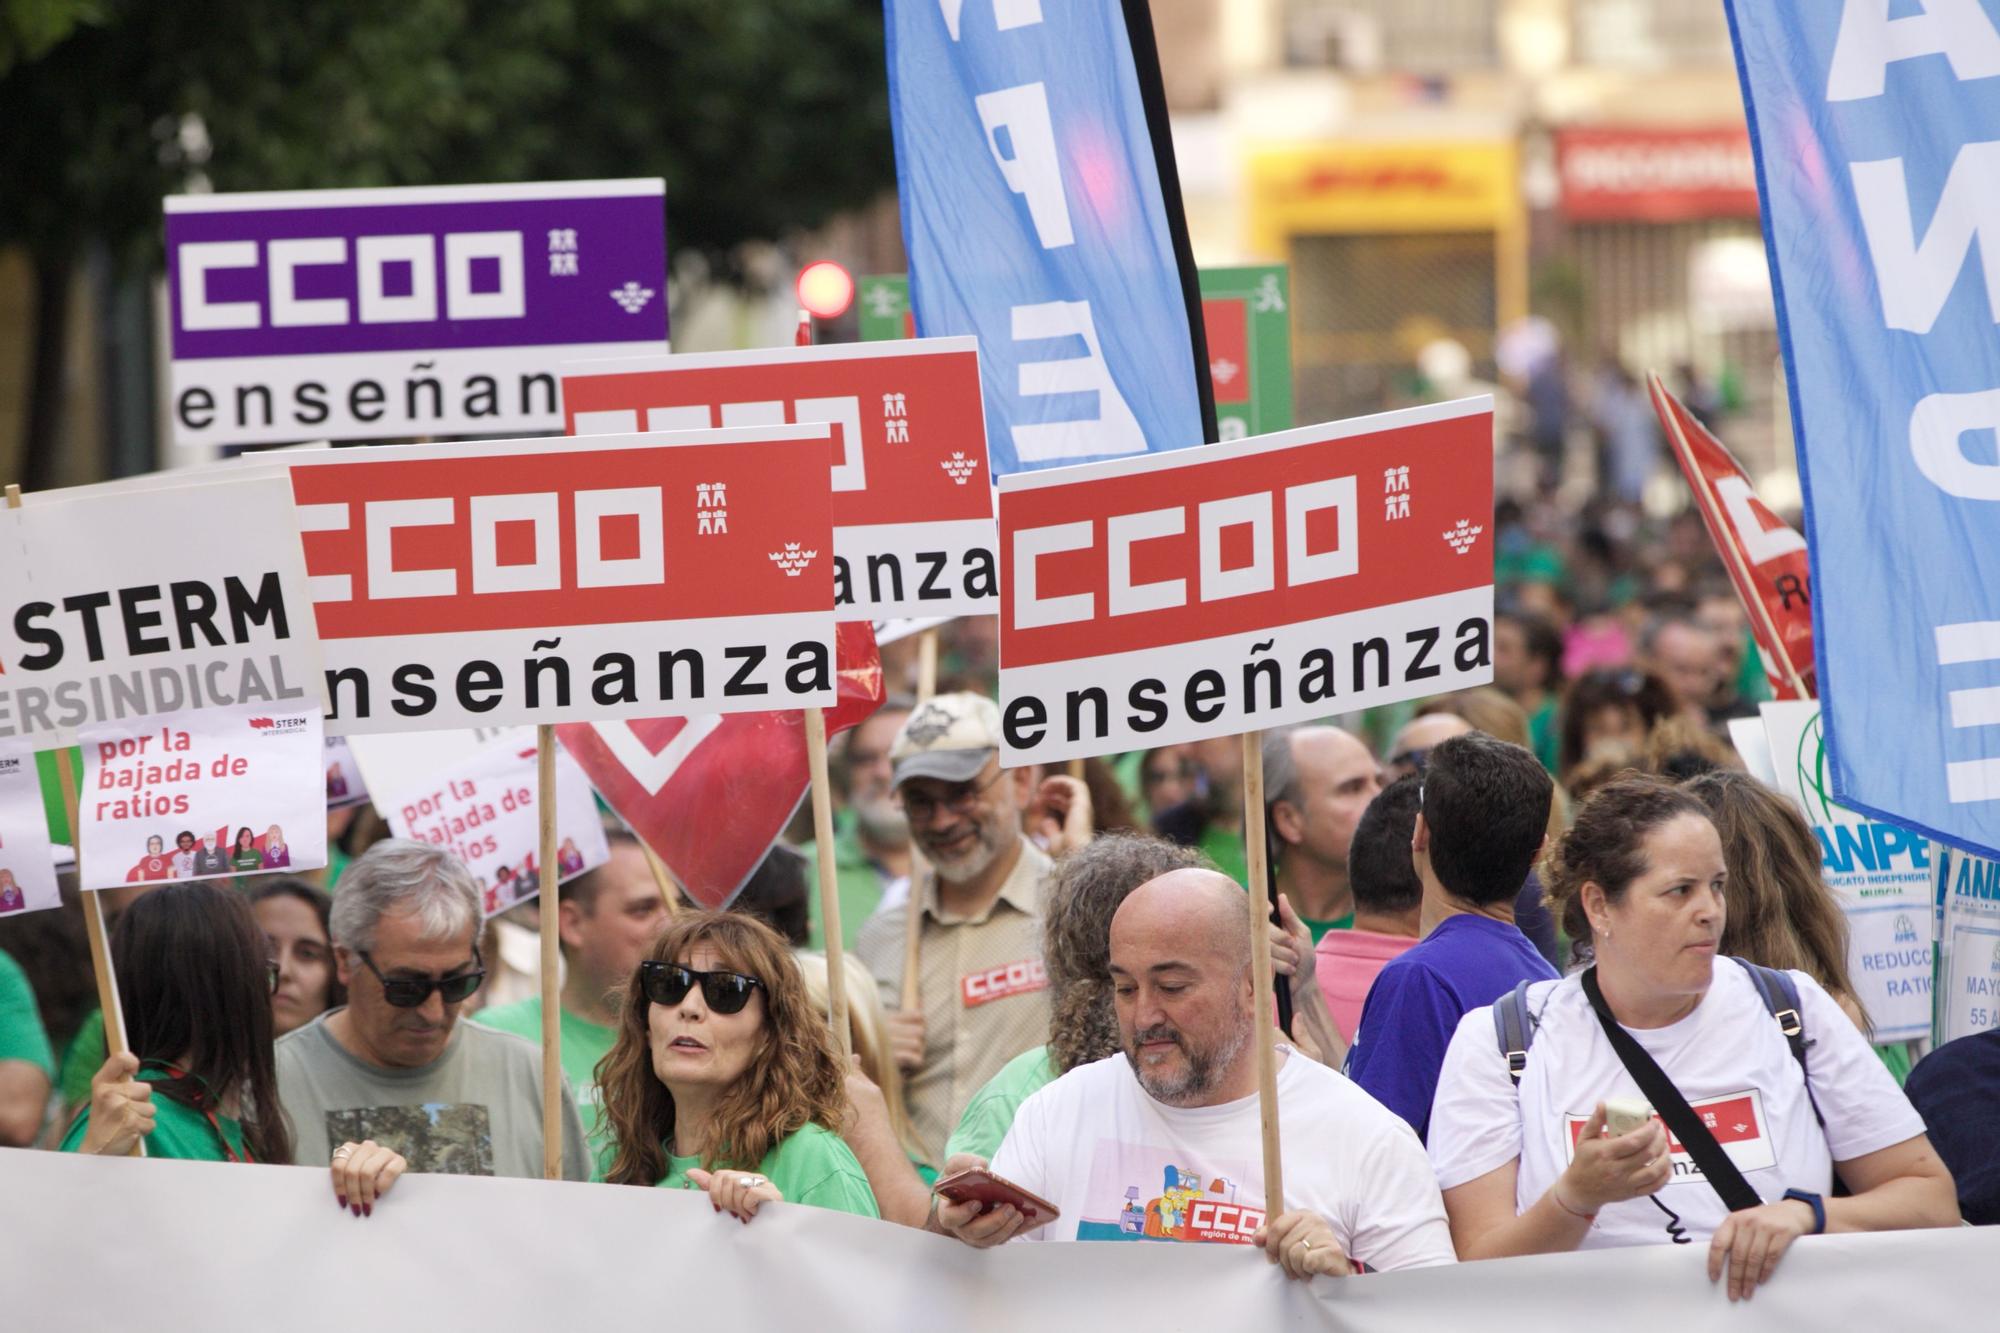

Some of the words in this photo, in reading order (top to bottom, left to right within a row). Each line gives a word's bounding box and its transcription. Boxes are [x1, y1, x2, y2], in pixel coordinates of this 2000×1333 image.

[178, 230, 526, 331] CCOO
[1013, 474, 1359, 630] CCOO
[14, 571, 291, 672] STERM
[1002, 616, 1492, 751] enseñanza
[98, 734, 154, 765] por
[163, 727, 191, 752] la
[98, 758, 201, 792] bajada
[211, 754, 249, 778] de
[96, 793, 190, 821] ratios
[402, 788, 446, 827] por
[449, 779, 477, 802] la
[501, 786, 532, 813] de
[1200, 1230, 1227, 1239] región
[1228, 1231, 1240, 1240] de
